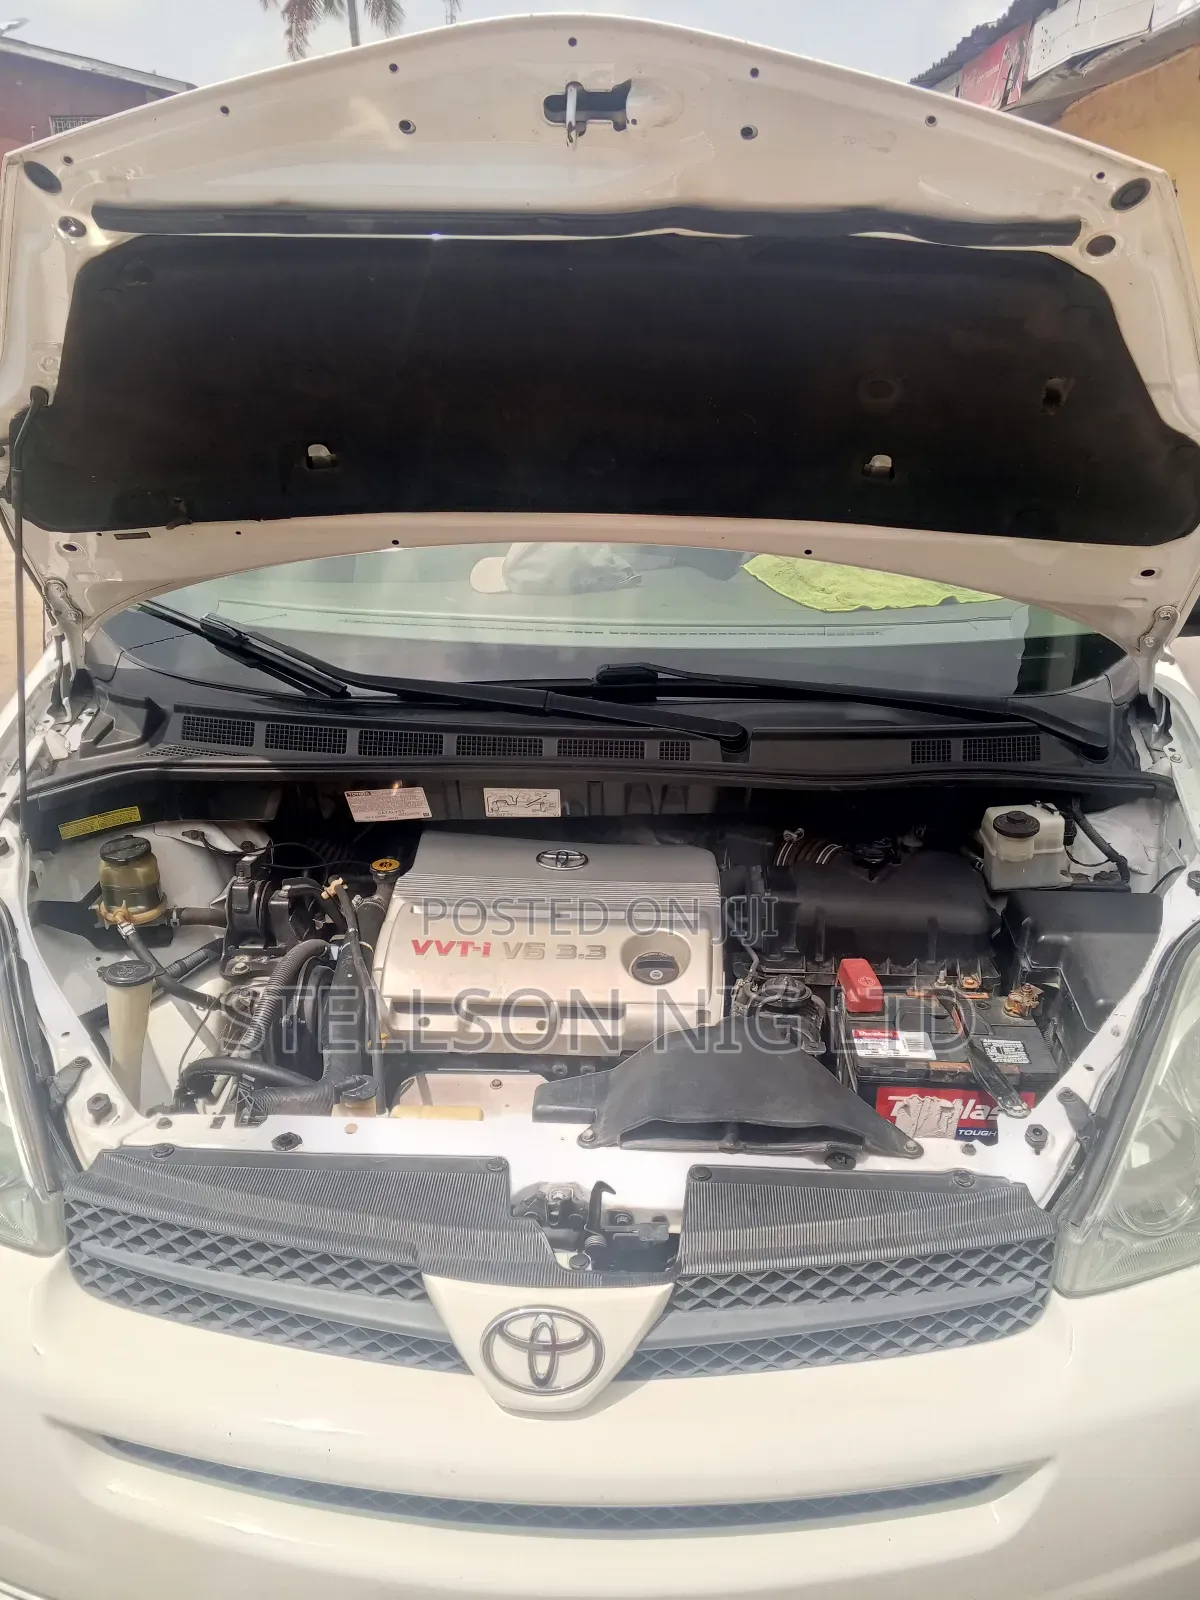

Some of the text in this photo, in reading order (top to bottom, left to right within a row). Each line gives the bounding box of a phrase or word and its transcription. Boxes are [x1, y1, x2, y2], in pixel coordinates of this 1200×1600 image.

[411, 939, 607, 960] VVT-i V6 3.3
[957, 1129, 997, 1137] TOUGH
